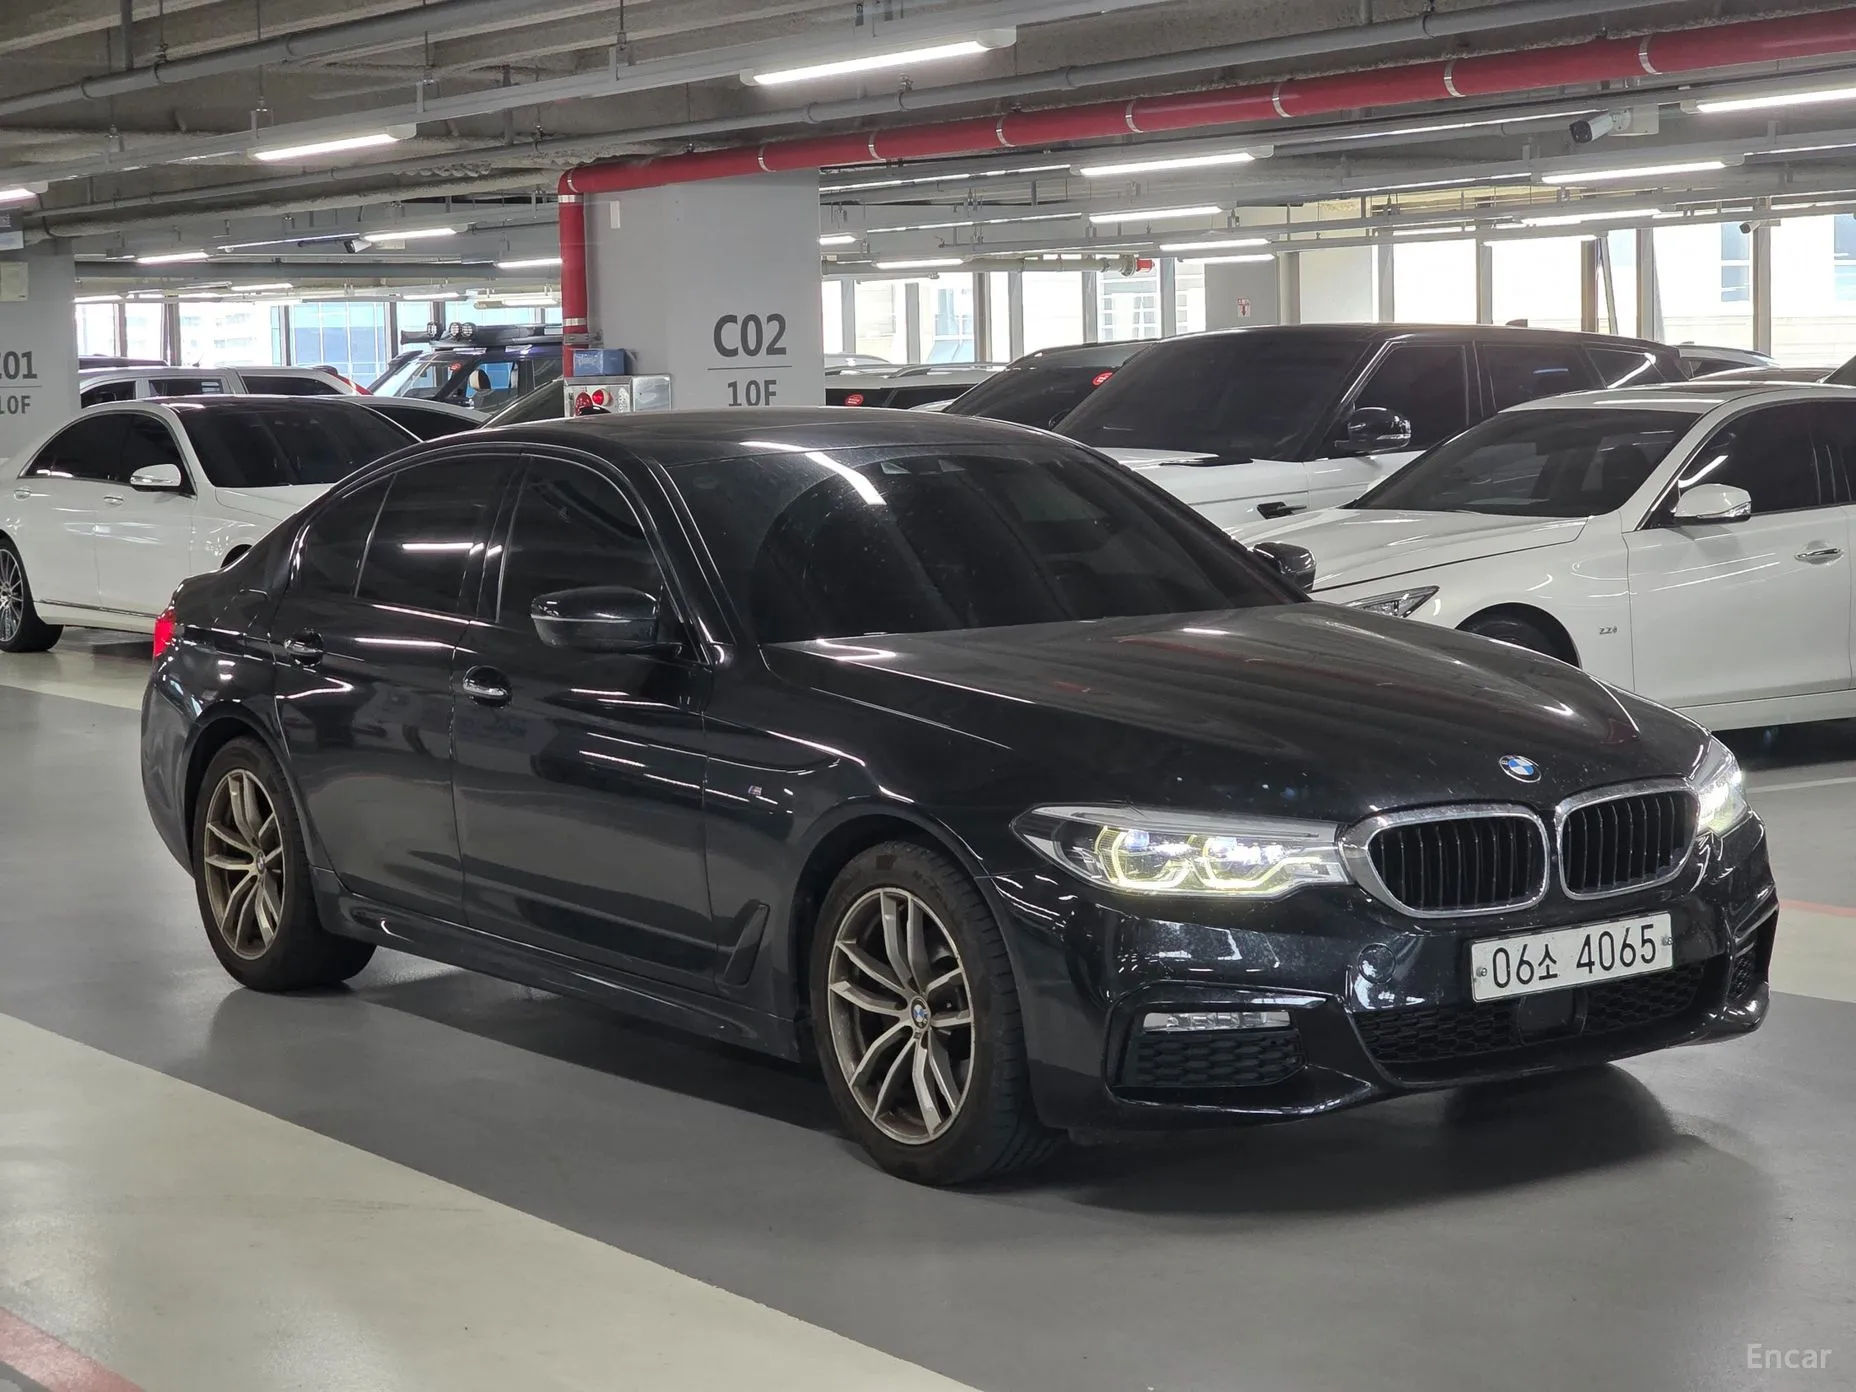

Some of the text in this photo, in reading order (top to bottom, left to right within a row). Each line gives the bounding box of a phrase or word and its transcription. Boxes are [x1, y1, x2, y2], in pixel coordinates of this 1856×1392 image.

[713, 313, 787, 358] C02
[0, 351, 38, 380] 01
[727, 379, 777, 407] 10F
[1492, 923, 1656, 989] 06소 4065
